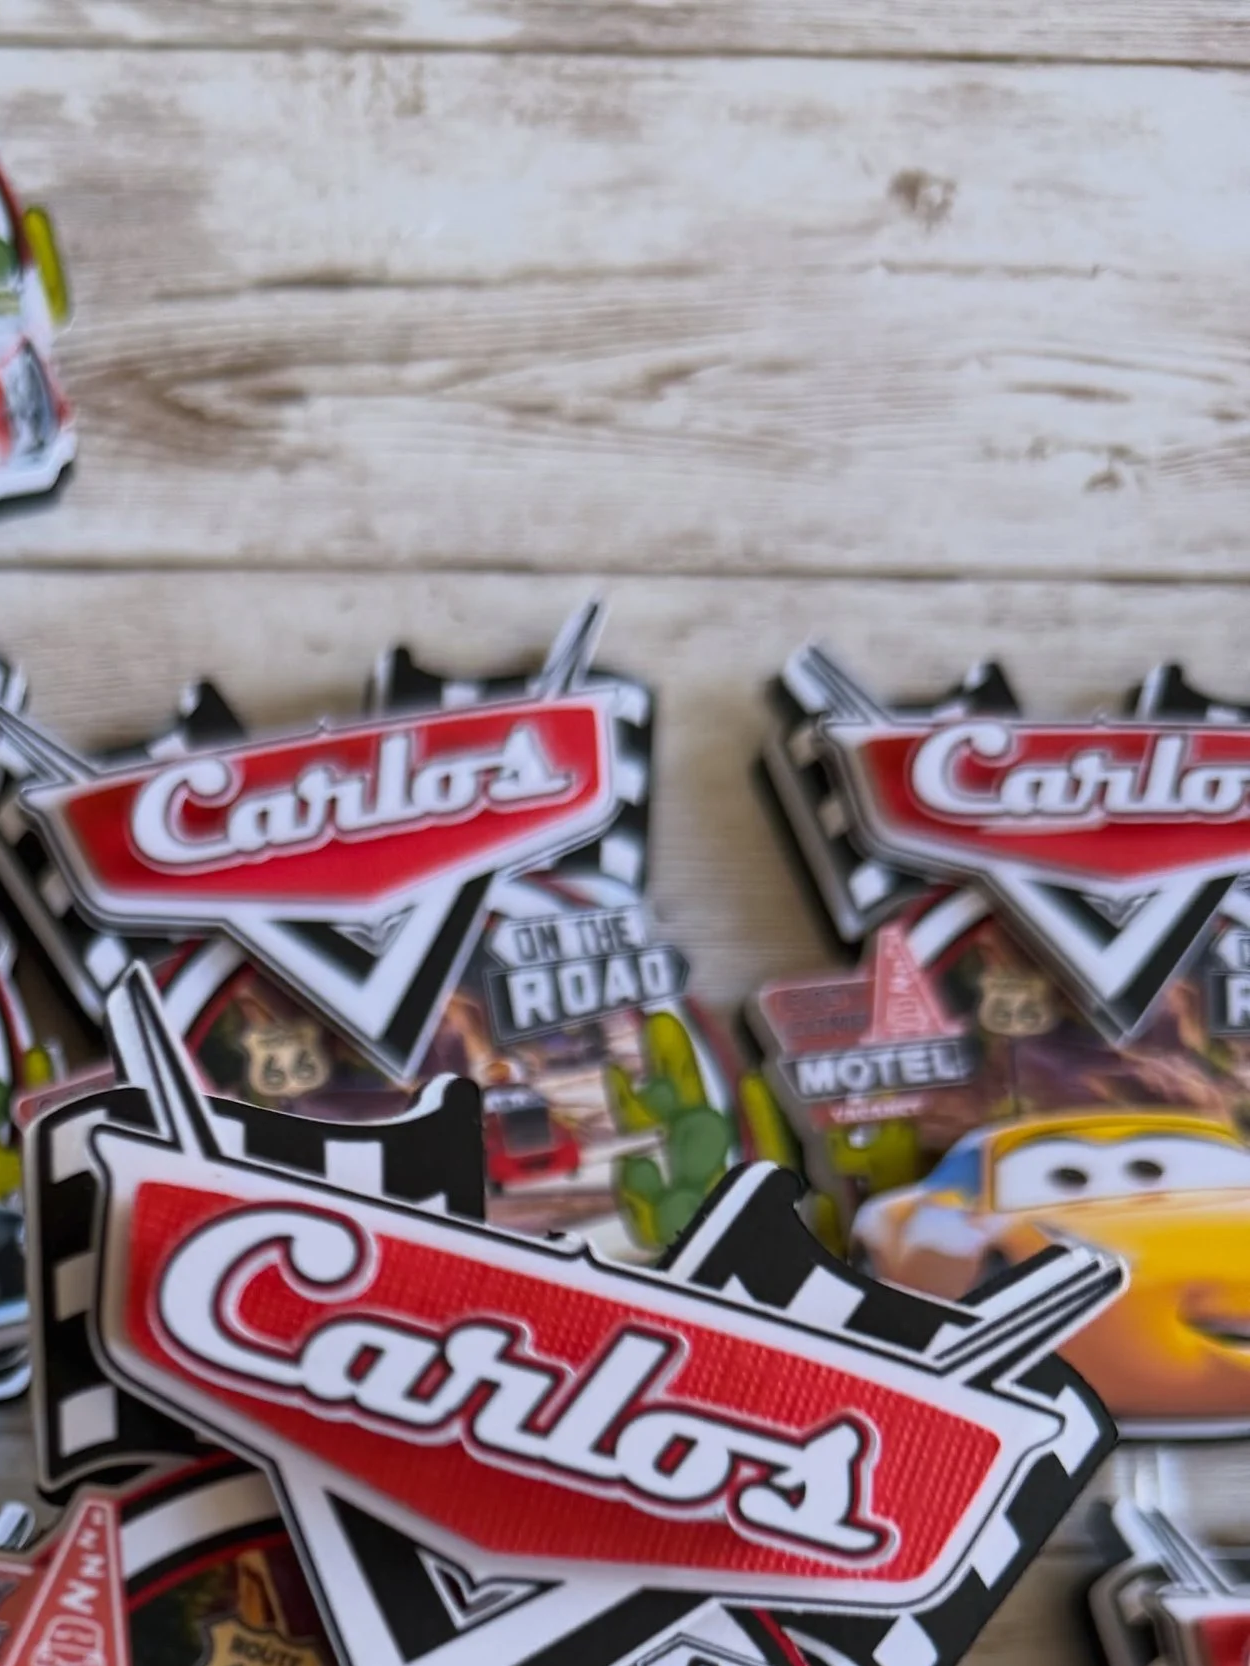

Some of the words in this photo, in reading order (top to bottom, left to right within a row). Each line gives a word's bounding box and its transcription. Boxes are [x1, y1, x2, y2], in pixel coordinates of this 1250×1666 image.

[131, 724, 574, 864] Carlos
[911, 722, 1250, 816] Carlo
[515, 918, 562, 963] ON
[569, 913, 632, 954] THE
[506, 951, 673, 1031] ROAD
[261, 1049, 321, 1090] 66
[796, 1042, 964, 1096] MOTEL
[160, 1209, 891, 1554] Carlos
